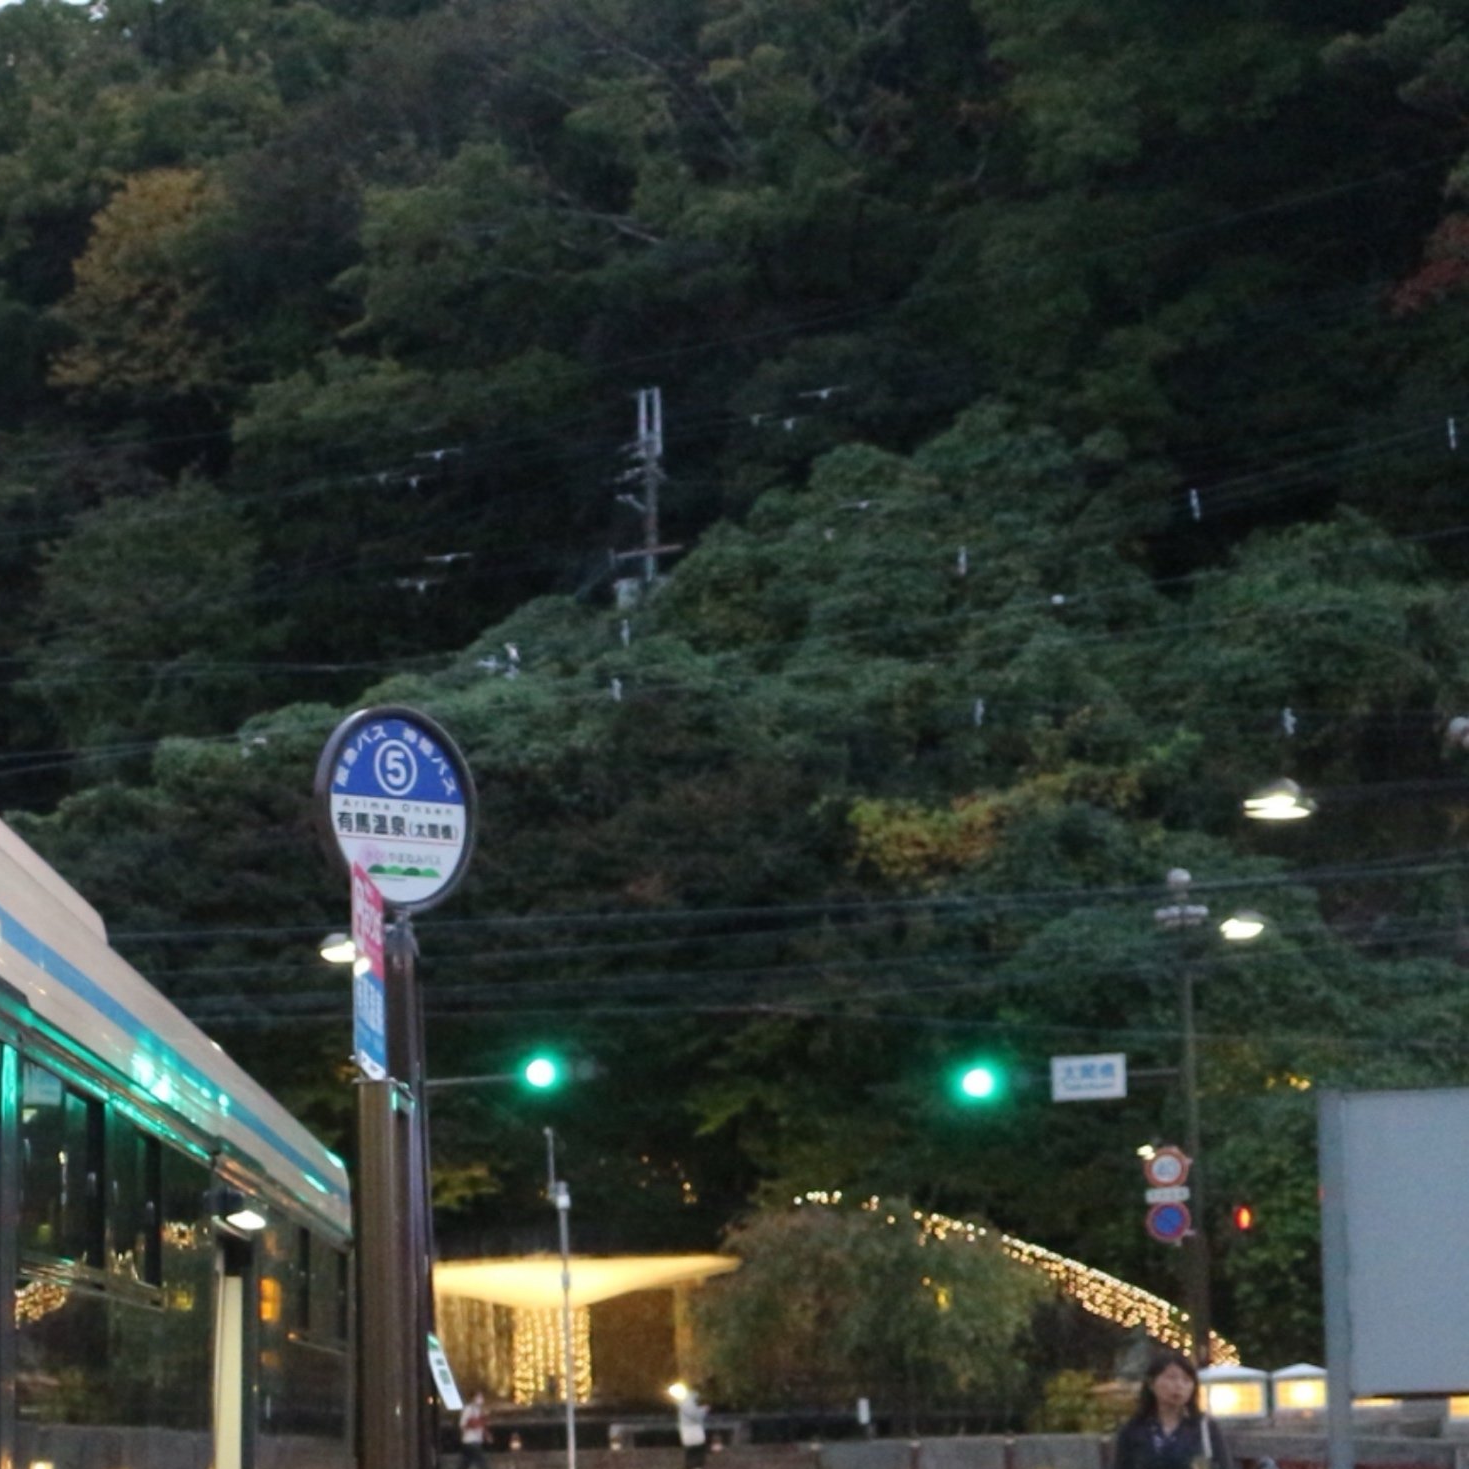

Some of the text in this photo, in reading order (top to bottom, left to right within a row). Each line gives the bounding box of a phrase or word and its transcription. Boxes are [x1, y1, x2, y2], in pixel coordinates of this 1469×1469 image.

[385, 751, 407, 787] 5
[343, 799, 453, 815] Arima Onsen
